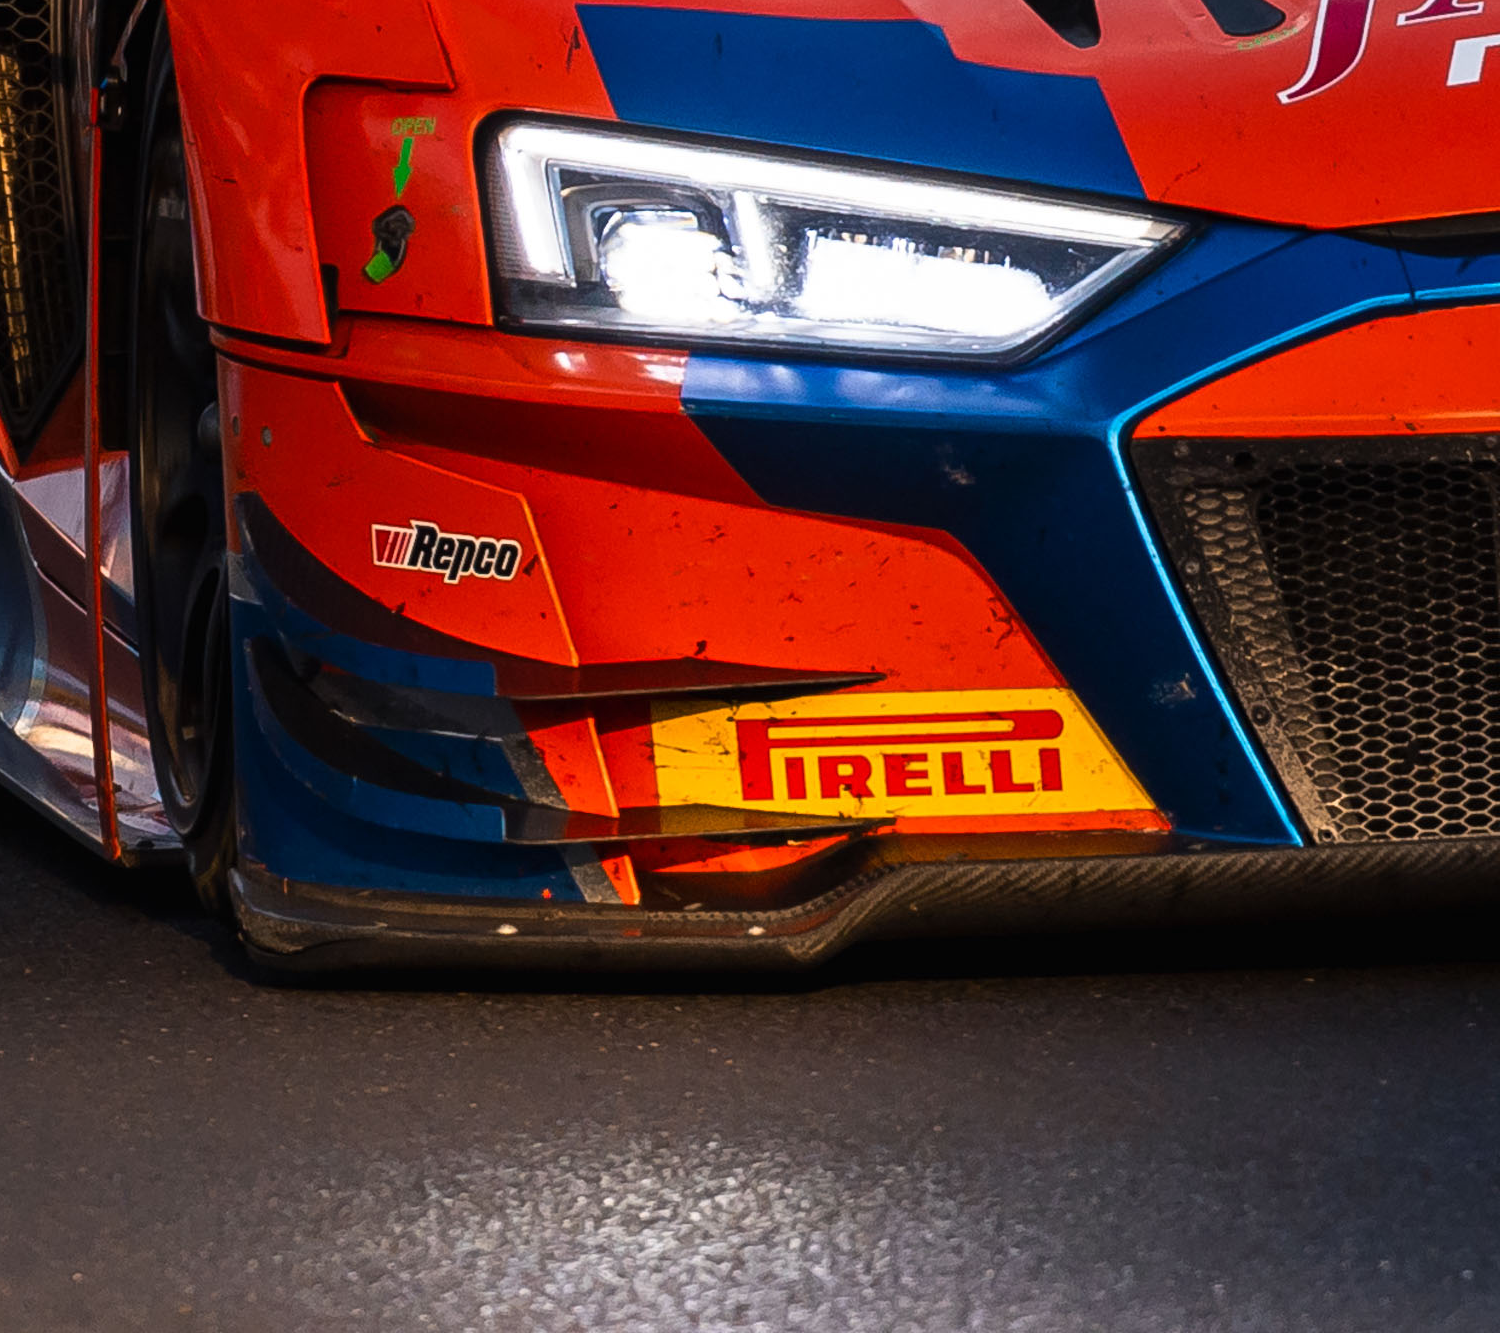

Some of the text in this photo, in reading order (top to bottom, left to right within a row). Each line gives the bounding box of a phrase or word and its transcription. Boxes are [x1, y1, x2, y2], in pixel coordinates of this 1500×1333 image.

[391, 116, 437, 136] OPEN
[406, 522, 520, 582] Repco
[736, 709, 1064, 803] PIRELLI
